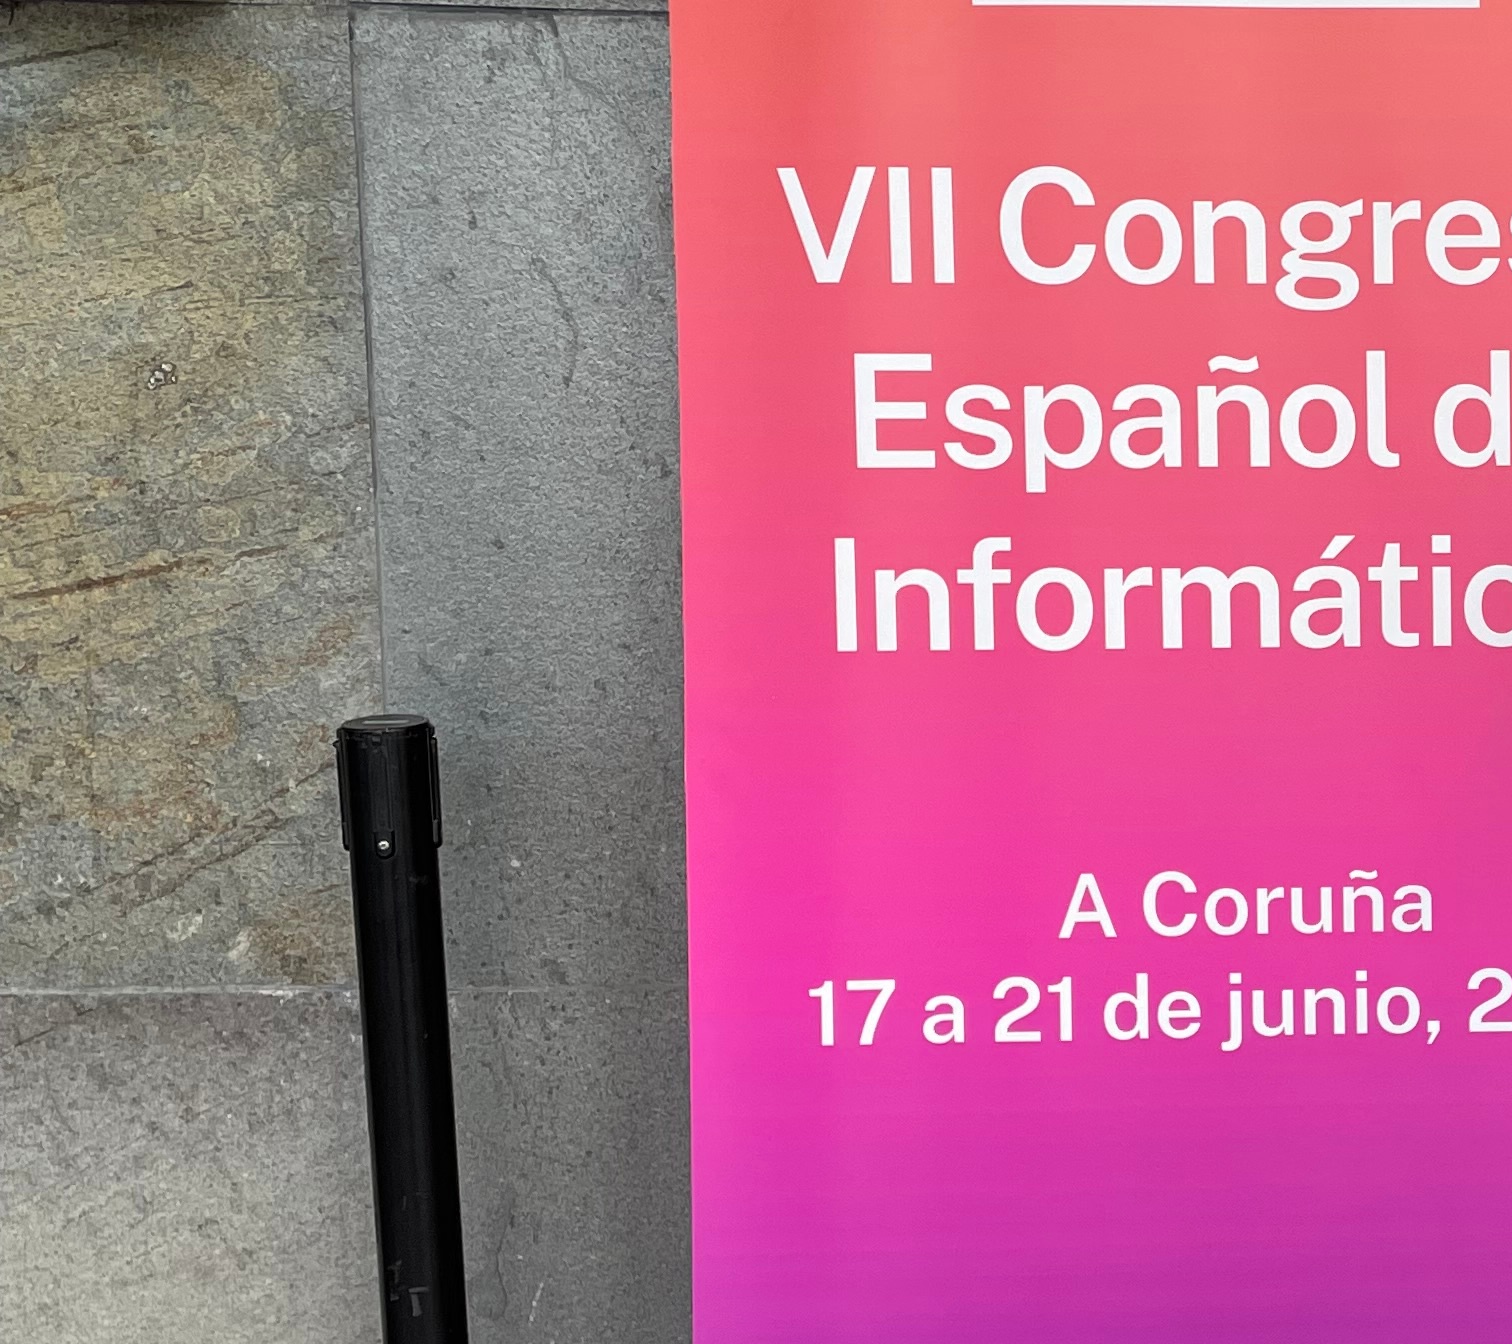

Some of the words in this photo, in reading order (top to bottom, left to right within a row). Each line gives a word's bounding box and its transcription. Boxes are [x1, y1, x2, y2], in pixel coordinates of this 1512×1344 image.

[777, 166, 955, 284] VII
[853, 350, 1400, 493] Español
[1058, 873, 1117, 939] A
[1143, 869, 1434, 937] Coruña
[808, 979, 896, 1046] 17
[922, 995, 966, 1044] a
[993, 976, 1073, 1042] 21
[1103, 972, 1201, 1041] de
[1221, 970, 1441, 1052] junio,
